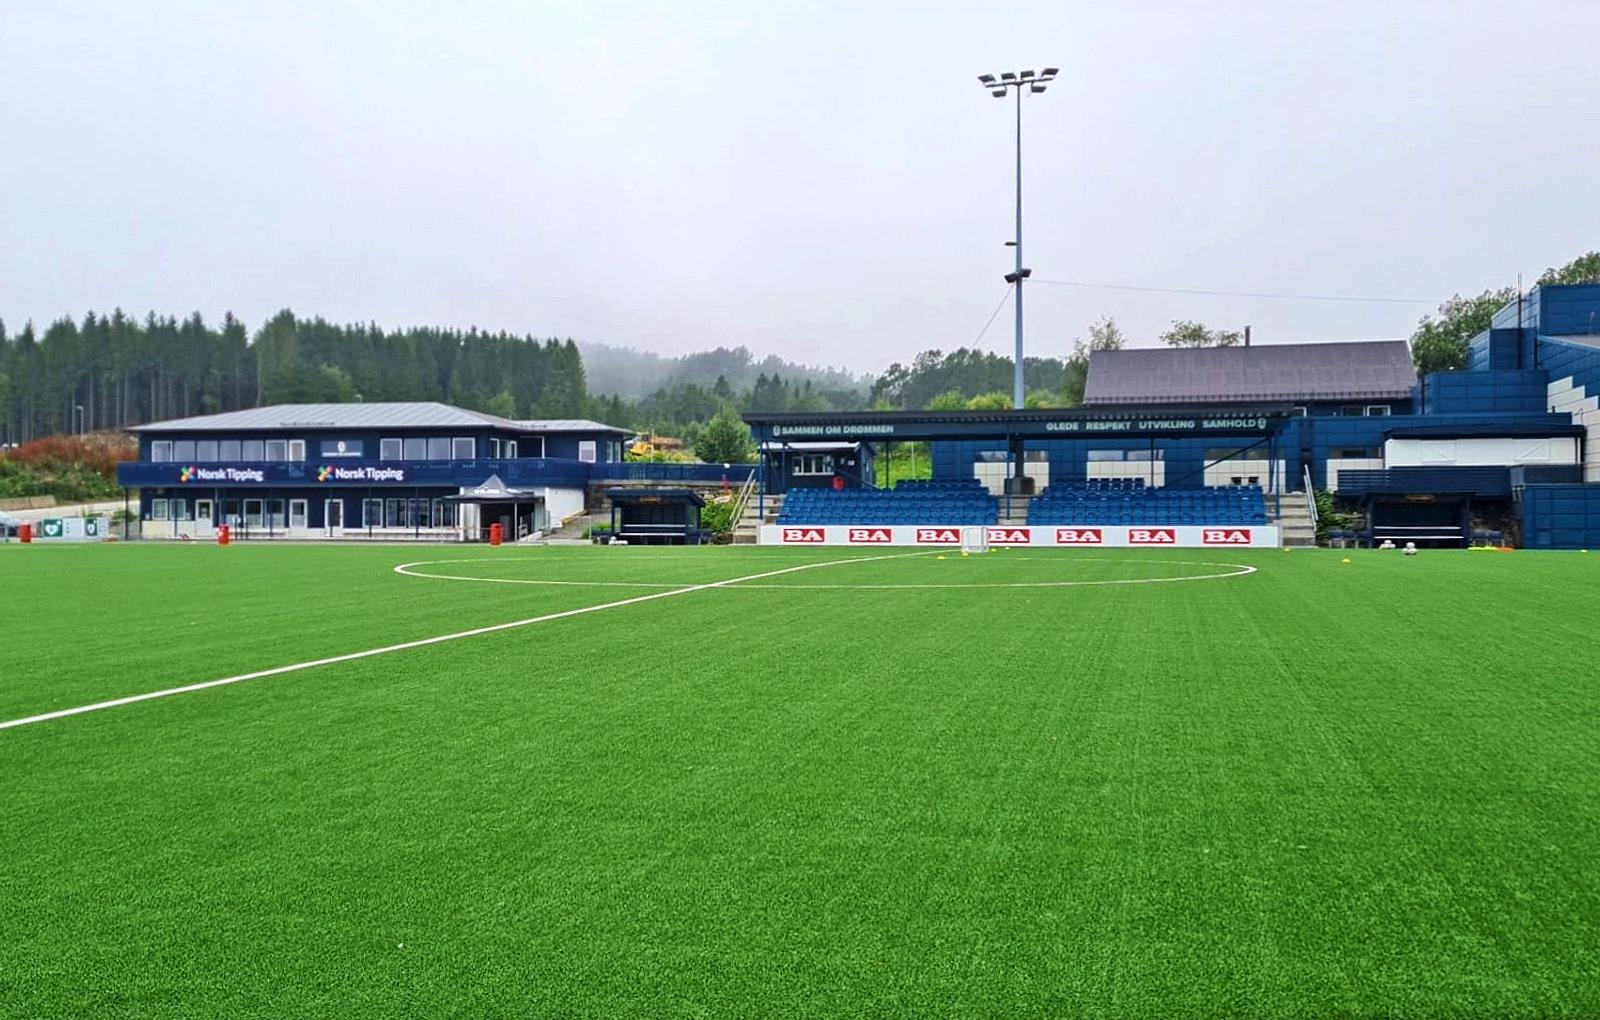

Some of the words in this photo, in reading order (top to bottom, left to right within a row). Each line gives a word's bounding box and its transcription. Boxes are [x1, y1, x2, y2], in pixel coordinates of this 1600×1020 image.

[782, 426, 823, 435] SAMMEN
[825, 426, 841, 434] OM
[843, 425, 894, 434] DRØMMEN
[1046, 422, 1079, 431] GLEDE
[1086, 421, 1131, 430] RESPEKT
[1139, 420, 1195, 429] UTVIKLING
[1202, 419, 1256, 428] SAMHOLD
[197, 468, 226, 479] Norsk
[226, 468, 264, 482] Tipping
[335, 467, 365, 479] Norsk
[365, 467, 404, 481] Tipping
[785, 529, 823, 541] BA
[851, 529, 889, 541] BA
[919, 530, 958, 541] BA
[989, 530, 1029, 542] BA
[1058, 530, 1100, 542] BA
[1131, 531, 1174, 542] BA
[1205, 531, 1250, 543] BA
